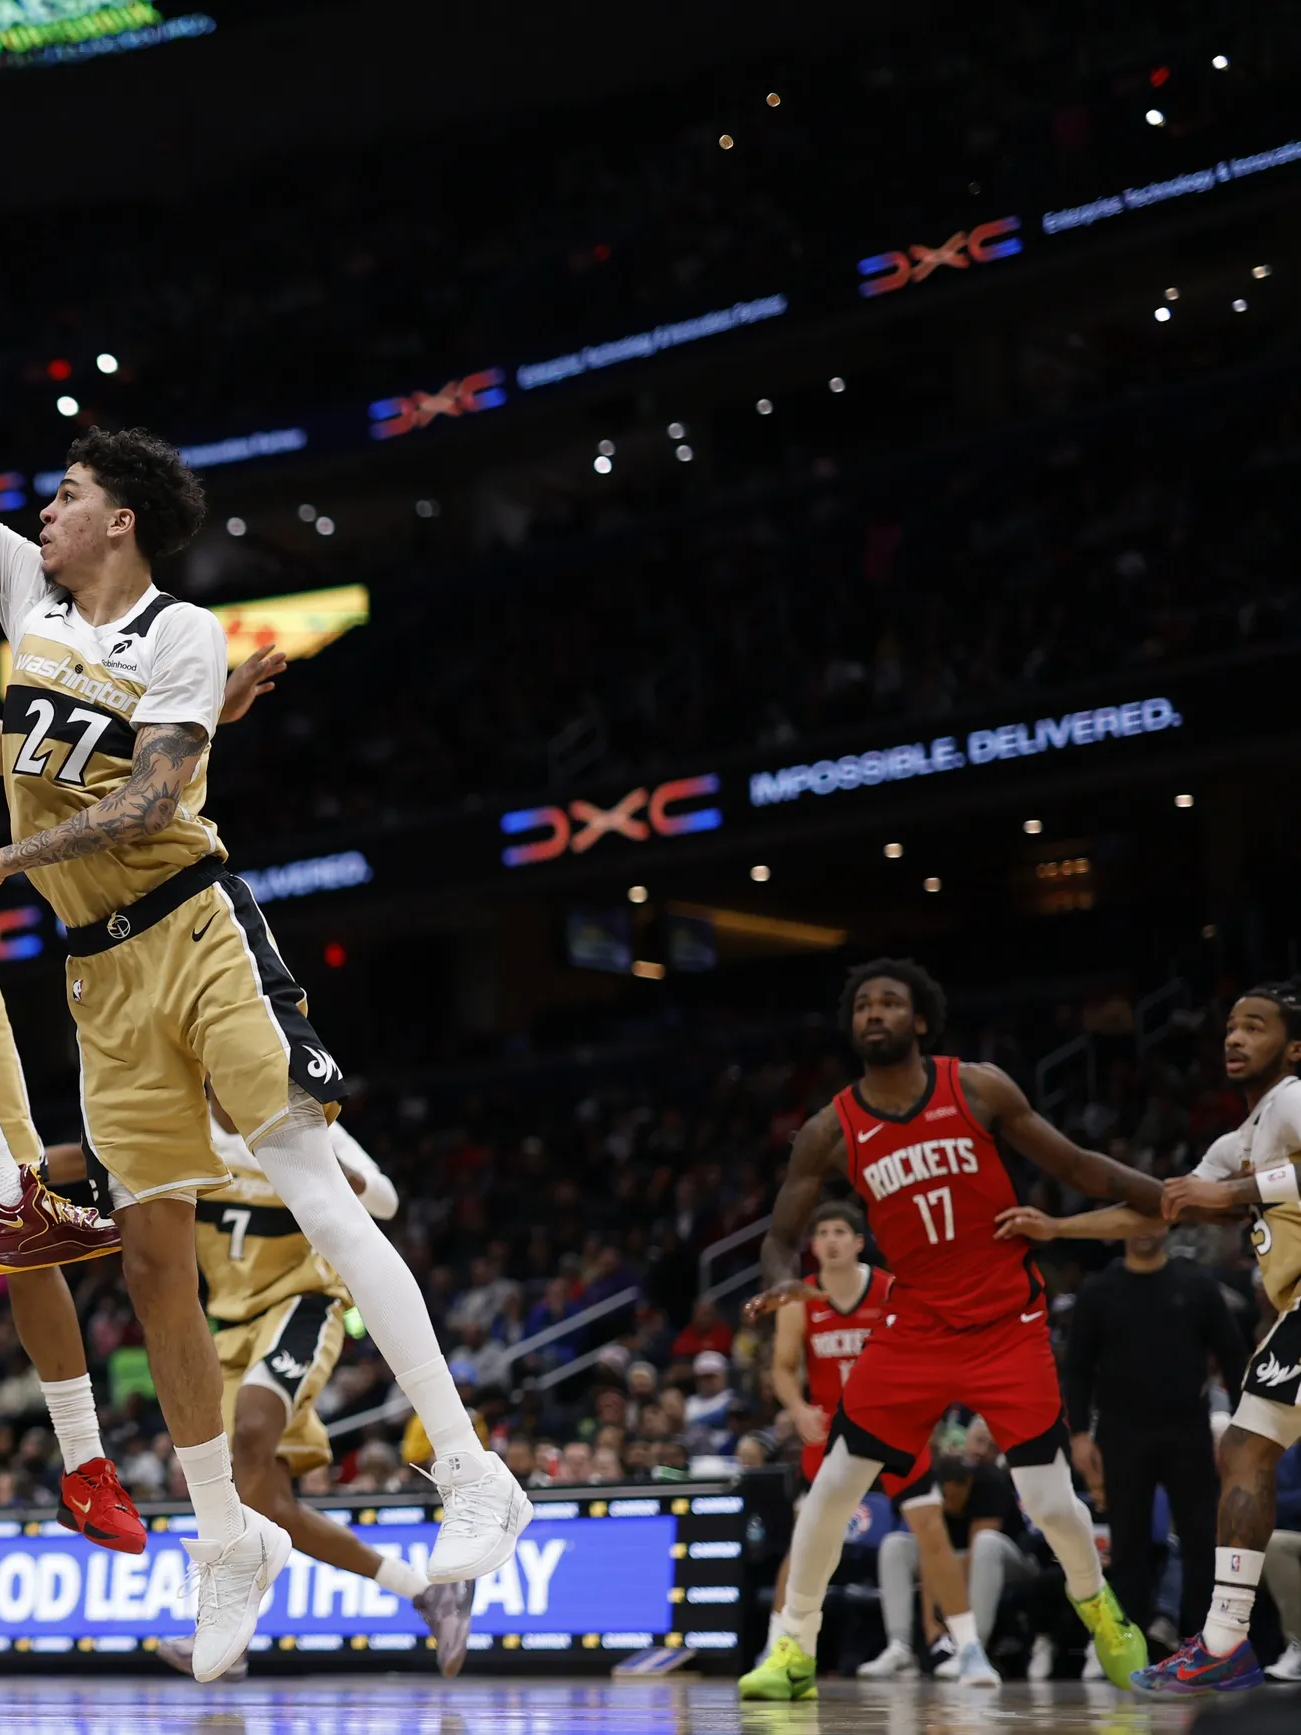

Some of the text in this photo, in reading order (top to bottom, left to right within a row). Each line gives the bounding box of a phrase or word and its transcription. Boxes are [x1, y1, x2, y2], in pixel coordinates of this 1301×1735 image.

[14, 652, 142, 713] washington
[12, 698, 113, 786] 27
[862, 1137, 978, 1202] ROCKETS
[222, 1209, 252, 1261] 7
[912, 1186, 955, 1244] 17
[84, 1549, 275, 1622] LEA
[409, 1540, 566, 1617] AY
